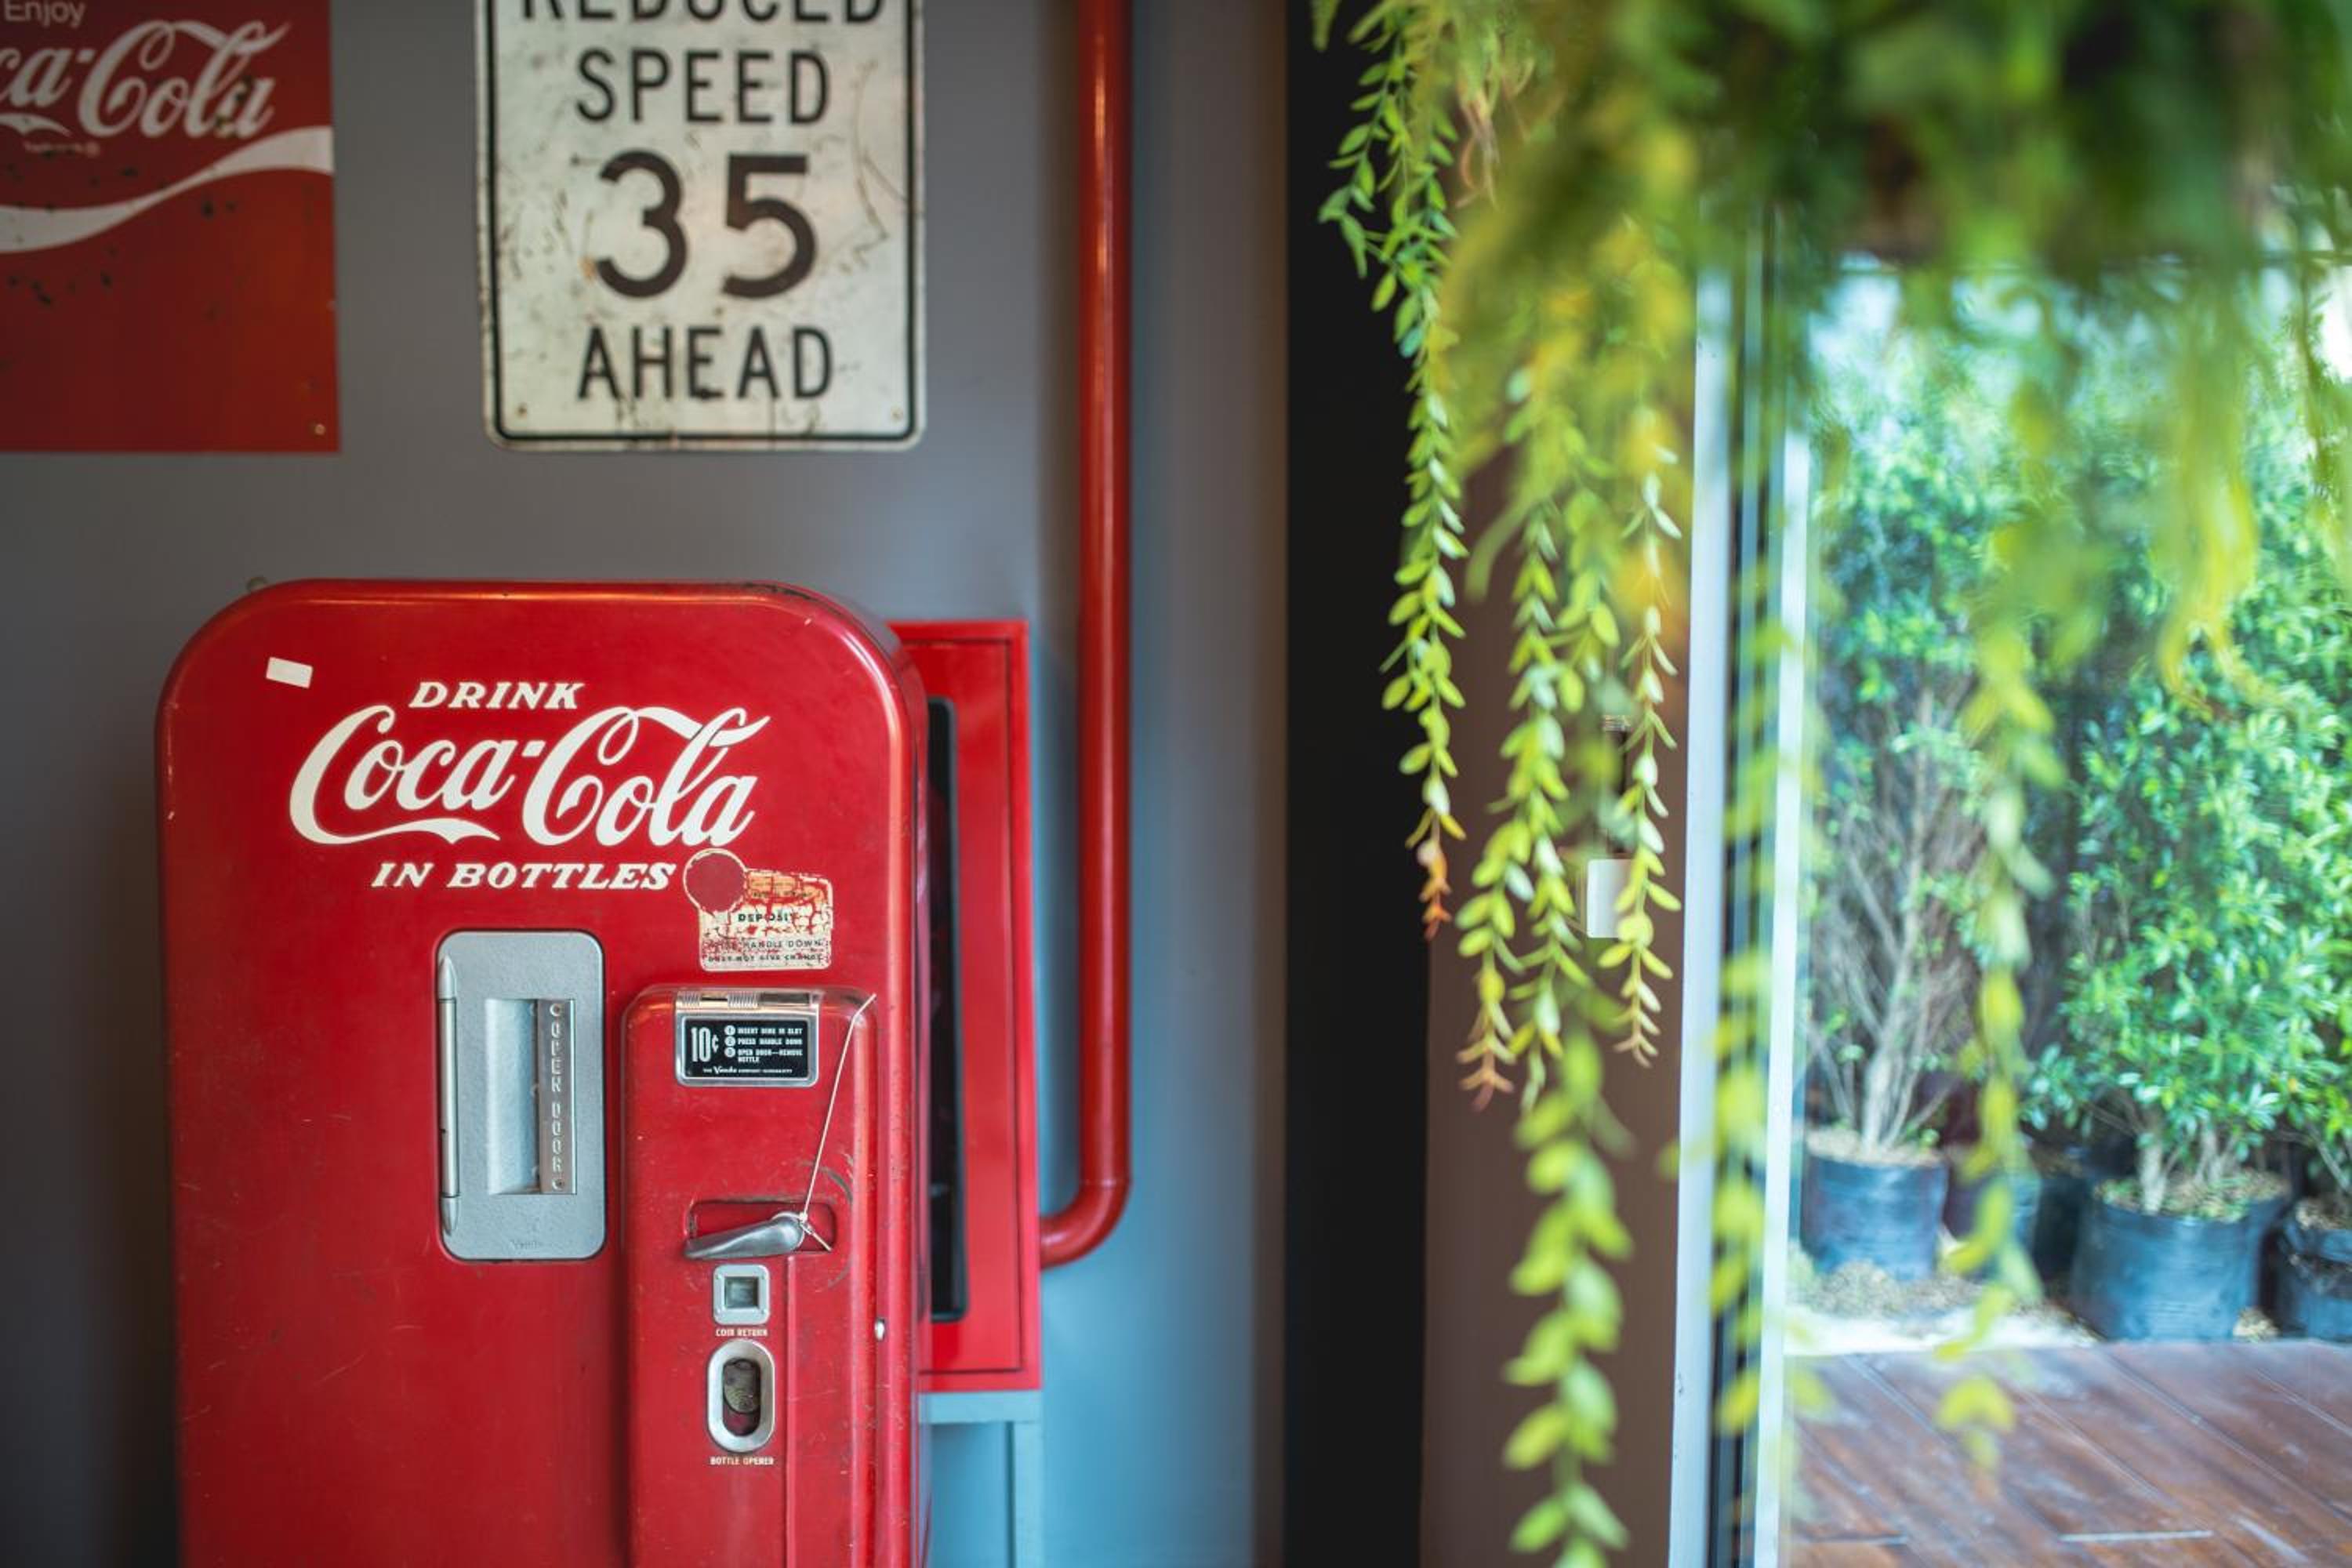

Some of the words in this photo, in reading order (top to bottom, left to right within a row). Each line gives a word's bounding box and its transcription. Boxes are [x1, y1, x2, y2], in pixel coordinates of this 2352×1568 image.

[5, 0, 85, 28] Enjoy
[576, 48, 829, 125] SPEED
[594, 149, 817, 299] 35
[576, 326, 833, 400] AHEAD
[408, 681, 585, 710] DRINK
[289, 706, 770, 847] Coca-Cola
[372, 862, 434, 888] IN
[447, 862, 676, 890] BOTTLES
[710, 1456, 739, 1465] BOTTLE
